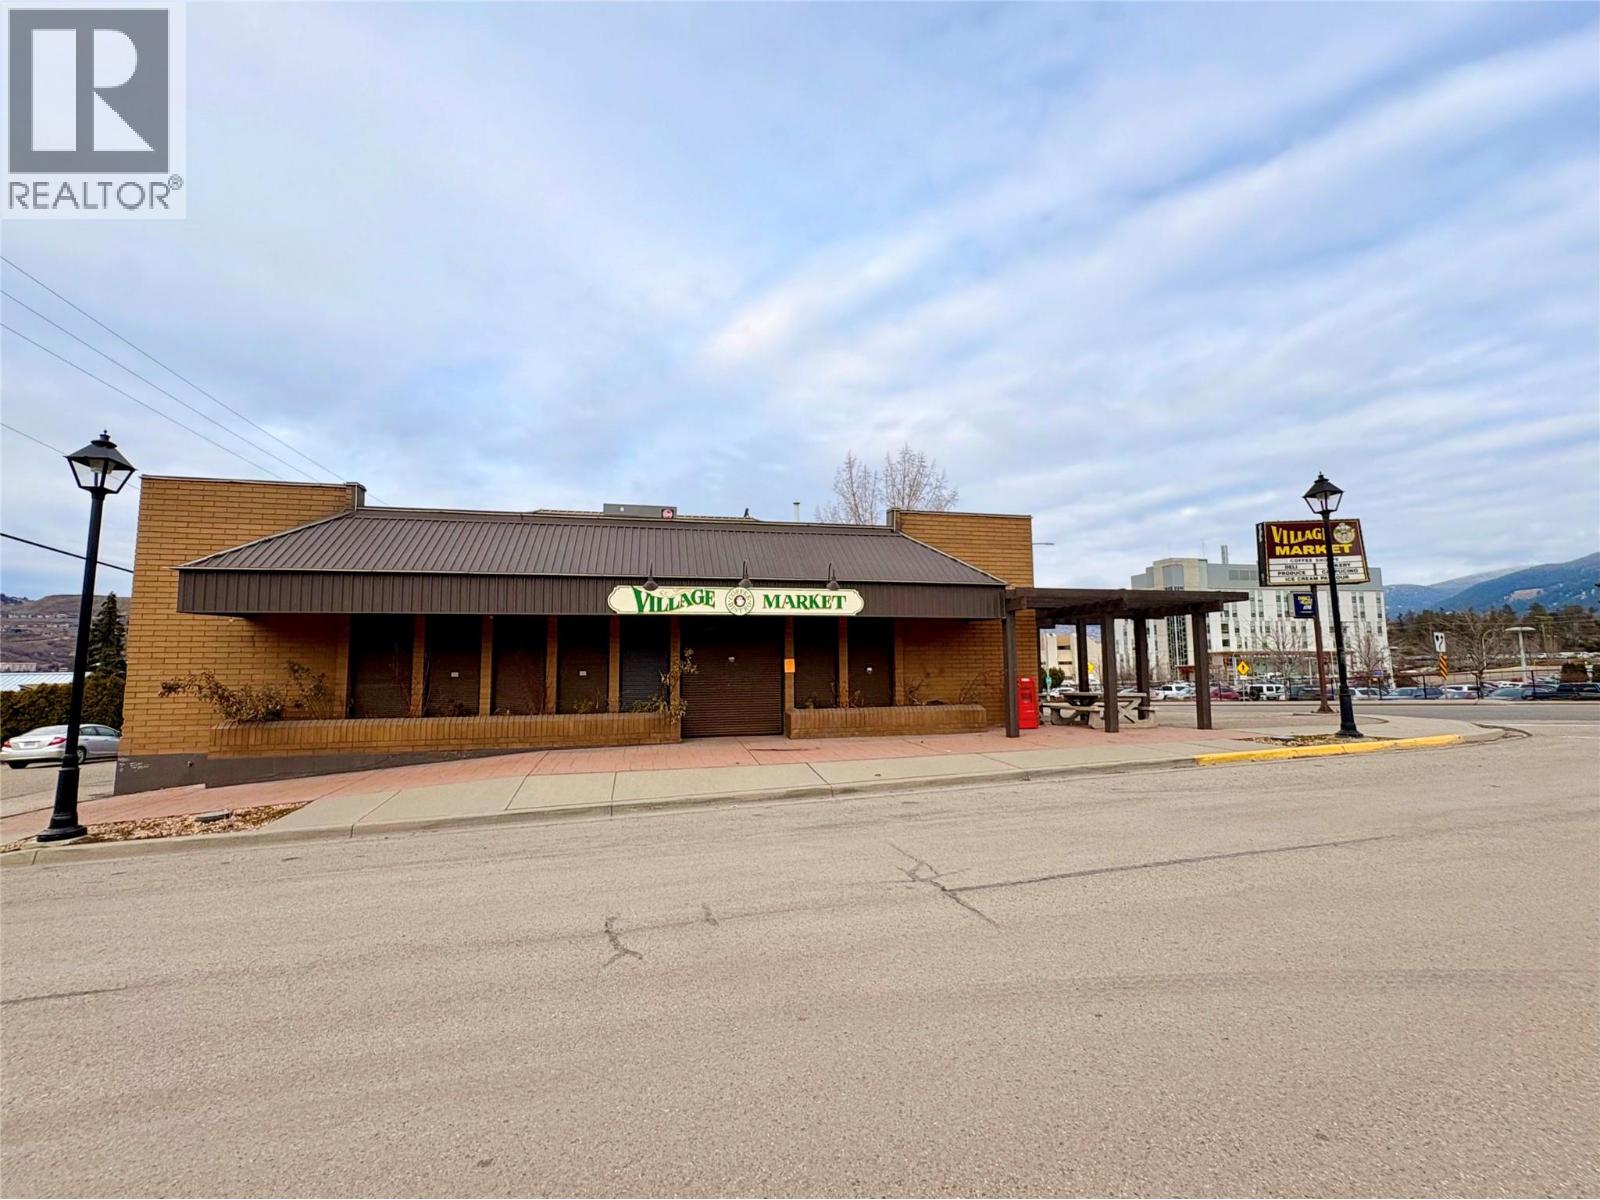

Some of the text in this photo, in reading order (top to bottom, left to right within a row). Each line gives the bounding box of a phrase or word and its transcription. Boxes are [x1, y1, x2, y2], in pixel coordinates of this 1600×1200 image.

[1275, 544, 1352, 556] MARKET
[632, 586, 847, 614] VILLAGE MARKET
